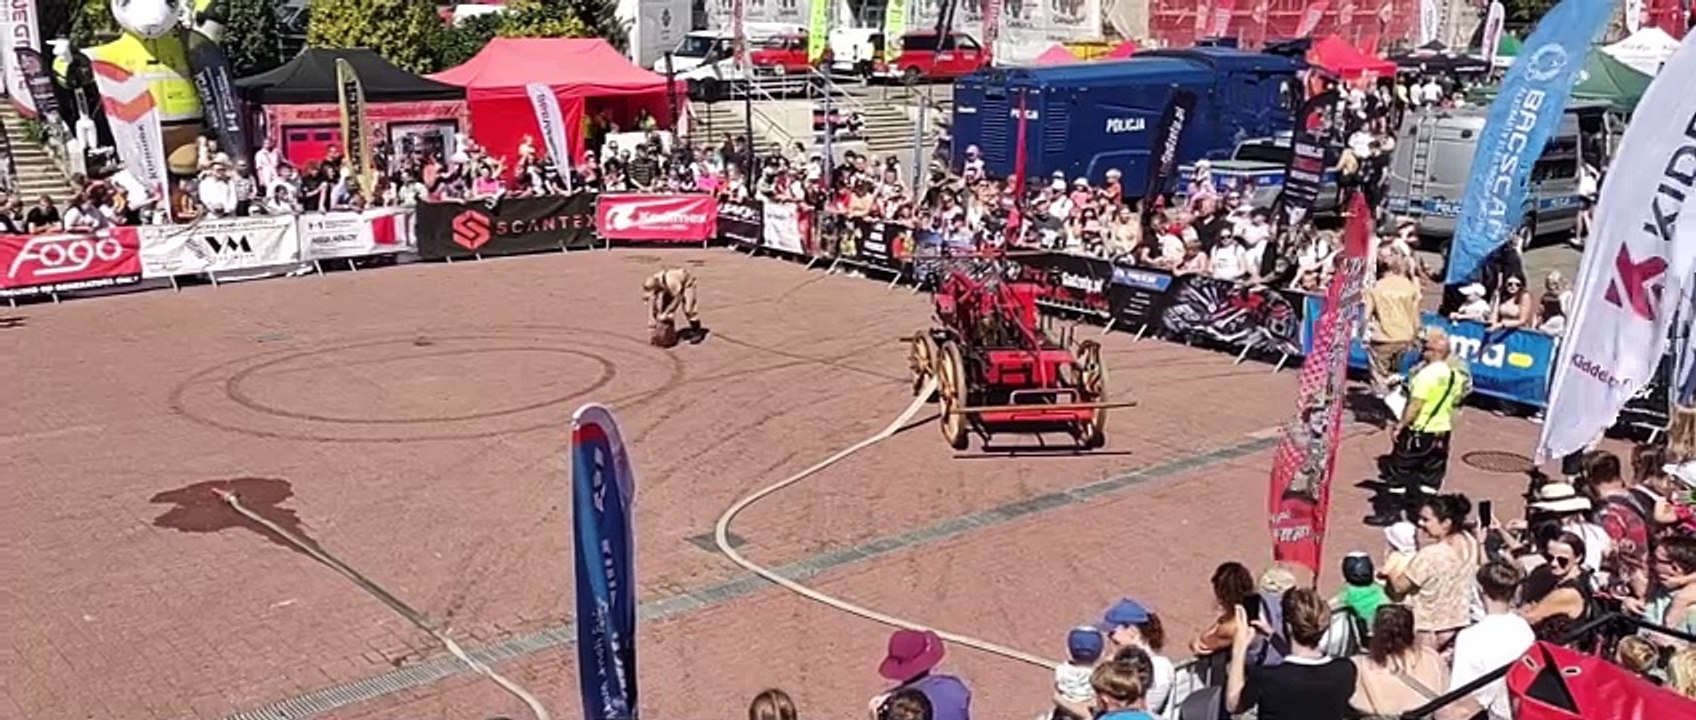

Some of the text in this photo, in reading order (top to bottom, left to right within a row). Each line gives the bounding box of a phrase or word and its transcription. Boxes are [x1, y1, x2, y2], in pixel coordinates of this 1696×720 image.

[1105, 117, 1146, 133] POLICJA
[496, 213, 598, 236] SCANTEX
[7, 229, 123, 280] Fogo
